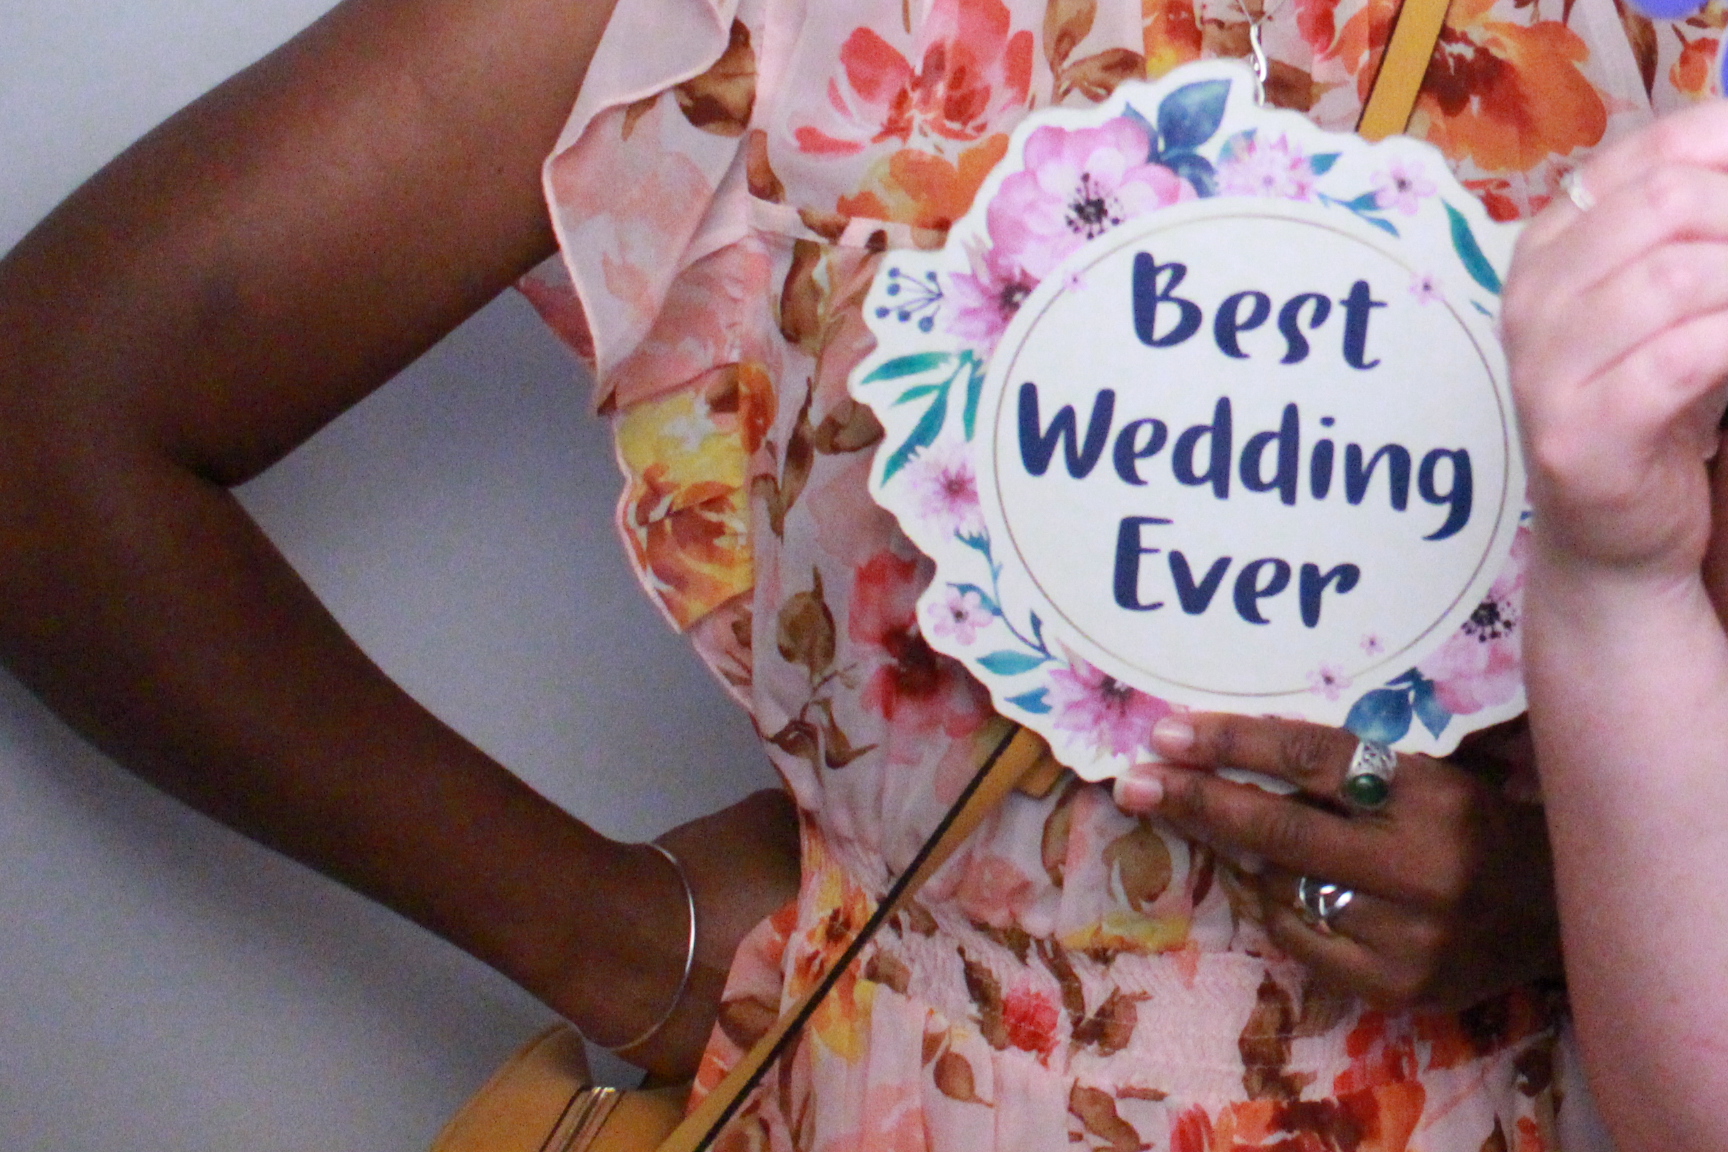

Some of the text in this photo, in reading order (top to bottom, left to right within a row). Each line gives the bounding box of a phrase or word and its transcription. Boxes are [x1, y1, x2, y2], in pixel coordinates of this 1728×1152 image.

[1130, 250, 1388, 370] Best
[1017, 382, 1475, 541] Wedding
[1112, 515, 1361, 628] Ever
